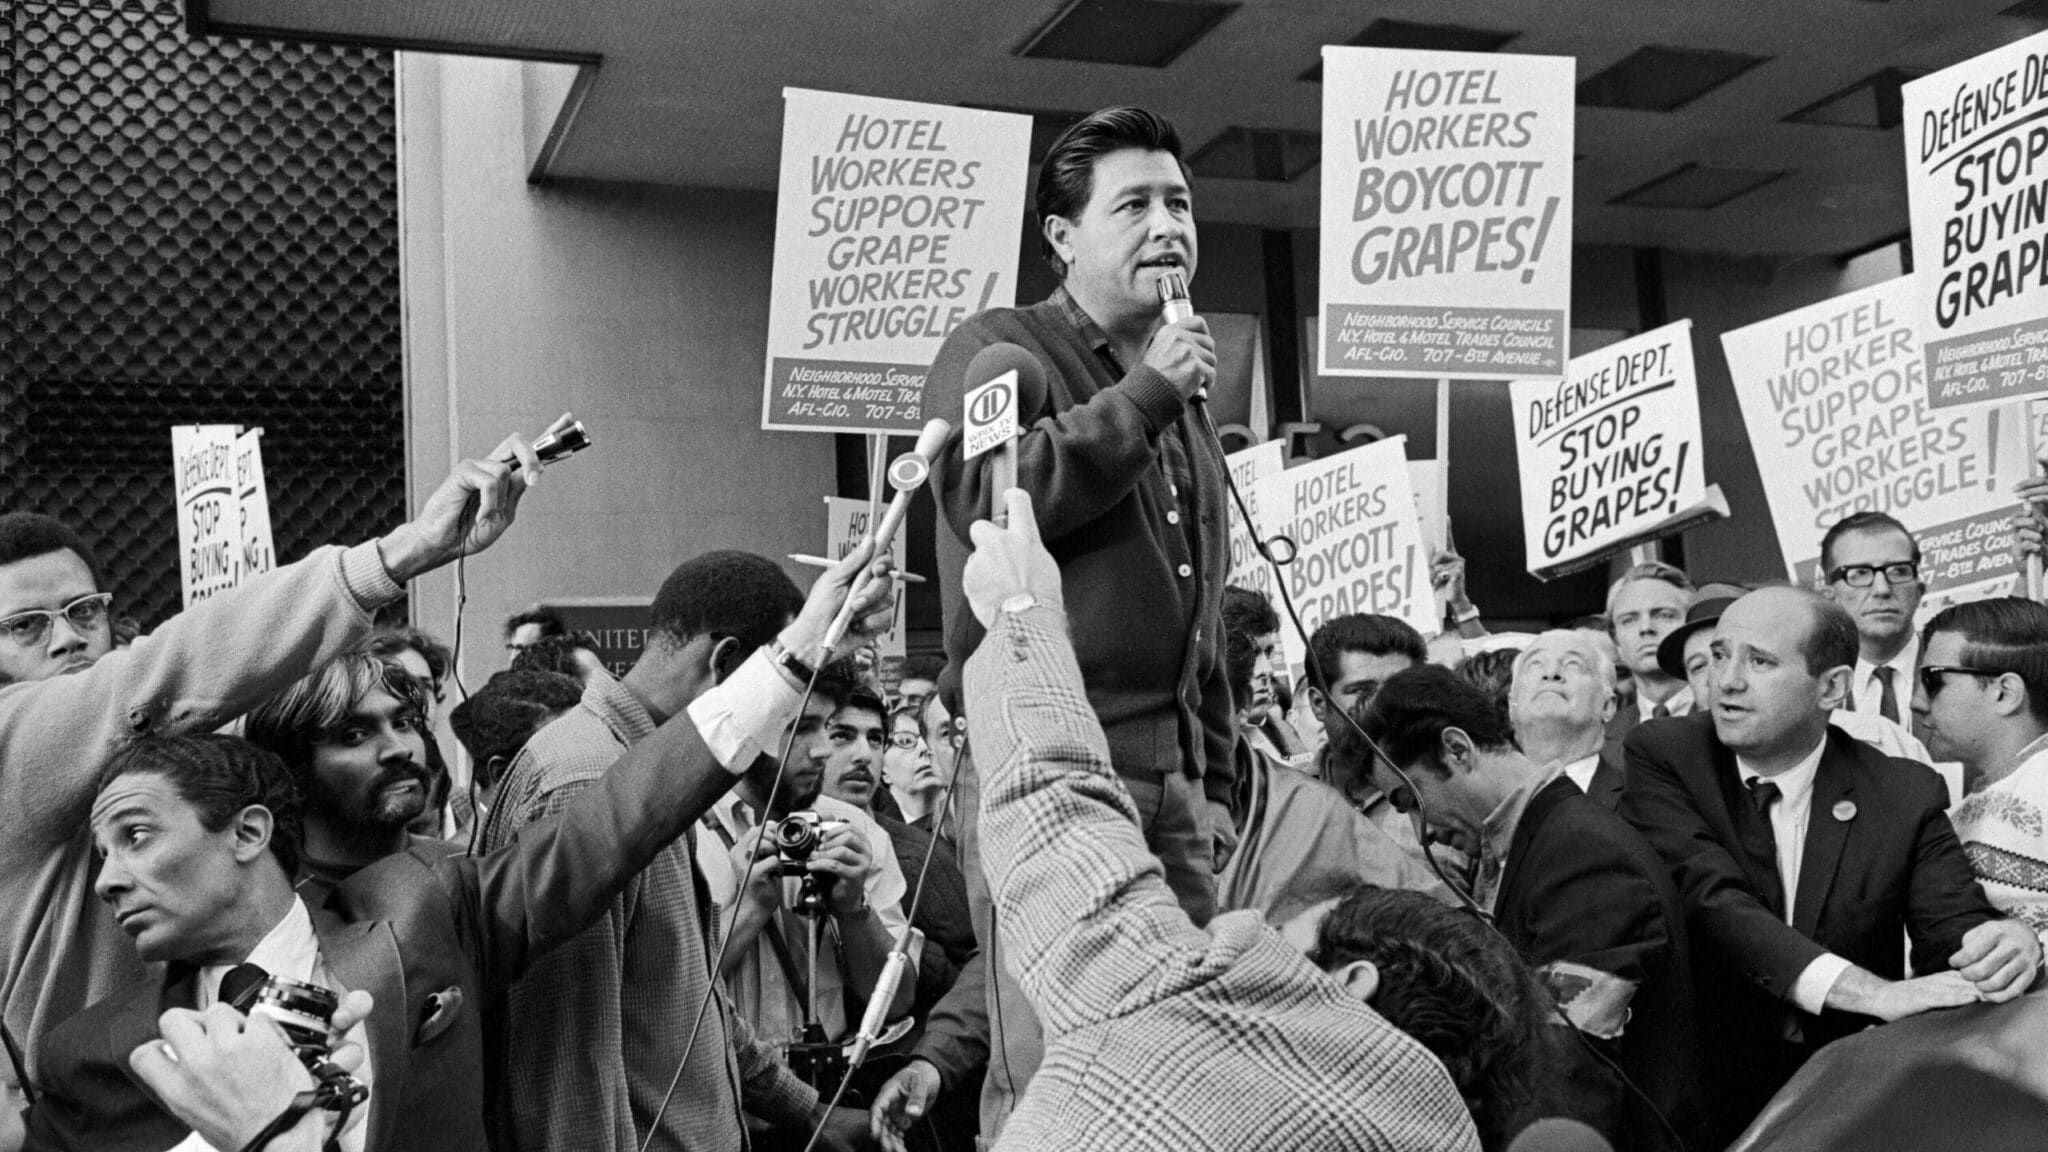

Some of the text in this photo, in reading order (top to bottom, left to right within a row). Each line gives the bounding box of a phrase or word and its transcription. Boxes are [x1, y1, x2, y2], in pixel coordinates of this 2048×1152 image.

[1384, 69, 1502, 113] HOTEL
[836, 113, 948, 153] HOTEL
[1354, 111, 1538, 163] WORKERS
[811, 155, 982, 195] WORKERS
[1955, 126, 2048, 211] STOP
[1352, 160, 1544, 222] BOYCOTT
[808, 194, 985, 237] SUPPORT
[1943, 178, 2048, 268] BUYIN
[827, 234, 950, 271] GRAPE
[1351, 196, 1561, 285] GRAPES!
[808, 268, 972, 310] WORKERS
[1337, 329, 1555, 349] N.Y. HOTEL & MOTEL TRADES COUNCIL
[1344, 311, 1552, 333] NEIGHBORHOOD SERVICE COUNCILS
[1784, 299, 1895, 369] HOTEL
[1490, 350, 1542, 366] AVENUE
[1616, 343, 1673, 392] DEPT.
[1767, 327, 1915, 413] WORKER
[1938, 337, 2010, 364] NEIGHBORHOOD
[1988, 352, 2023, 371] MOTEL
[2025, 346, 2048, 364] TRA
[782, 383, 921, 404] N.Y. HOTEL & MOTEL TRA
[789, 366, 926, 388] NEIGHBORHOOD SERVIC
[1781, 359, 1923, 448] SUPPOR
[970, 426, 1011, 454] NEWS
[1560, 405, 1640, 471] STOP
[1812, 396, 1935, 470] GRAPE
[1232, 459, 1258, 490] OTEL
[1550, 433, 1664, 514] BUYING
[1802, 416, 1968, 511] WORKERS
[1294, 462, 1362, 515] HOTEL
[1544, 441, 1689, 558] GRAPES!
[192, 500, 220, 543] STOP
[1280, 484, 1387, 556] WORKERS
[1965, 518, 2013, 540] COUNC
[191, 540, 229, 585] BUYING
[1291, 521, 1399, 600] BOYCOTT
[1931, 541, 1981, 566] TRADES
[1976, 553, 2014, 573] AVEN
[578, 628, 649, 648] NITE
